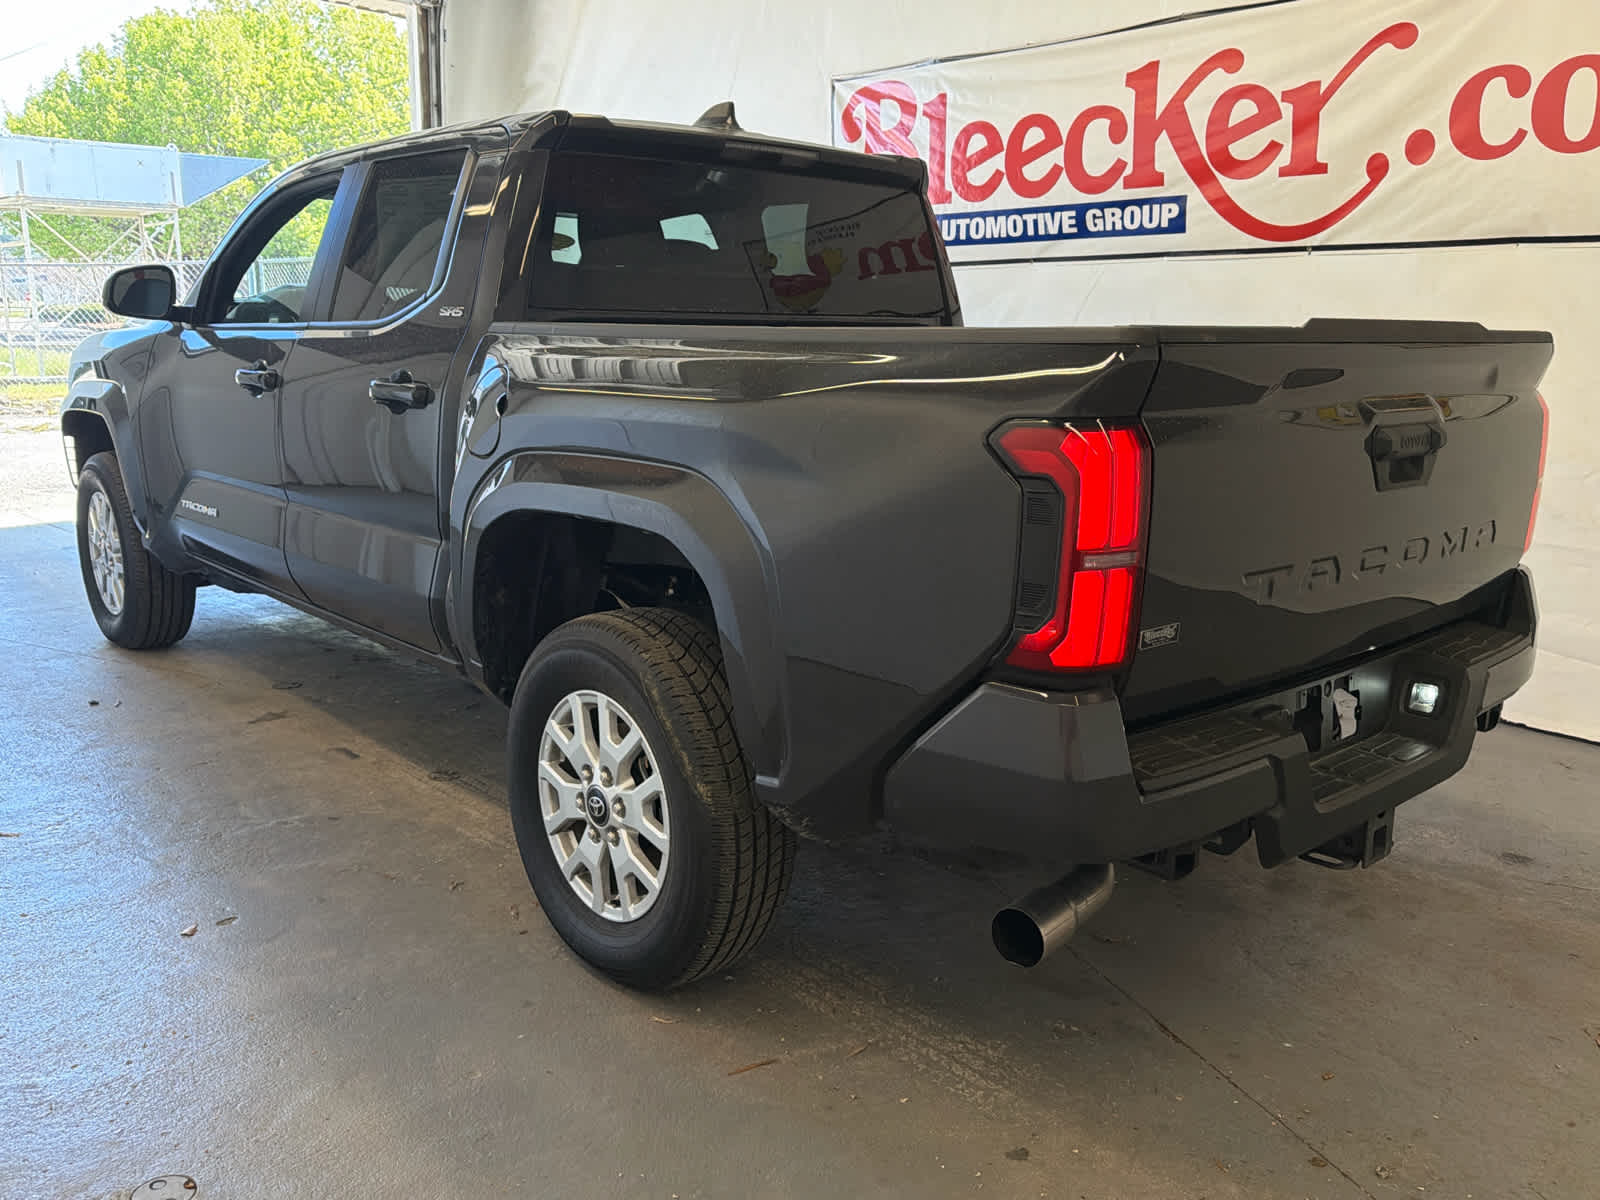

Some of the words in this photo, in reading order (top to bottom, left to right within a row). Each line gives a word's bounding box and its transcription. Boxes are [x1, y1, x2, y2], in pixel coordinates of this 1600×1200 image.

[937, 209, 1078, 241] UTOMOTIVE
[1084, 202, 1181, 233] GROUP
[439, 306, 465, 317] SR5
[180, 498, 217, 518] TACOMA
[1241, 519, 1499, 604] TACOMA
